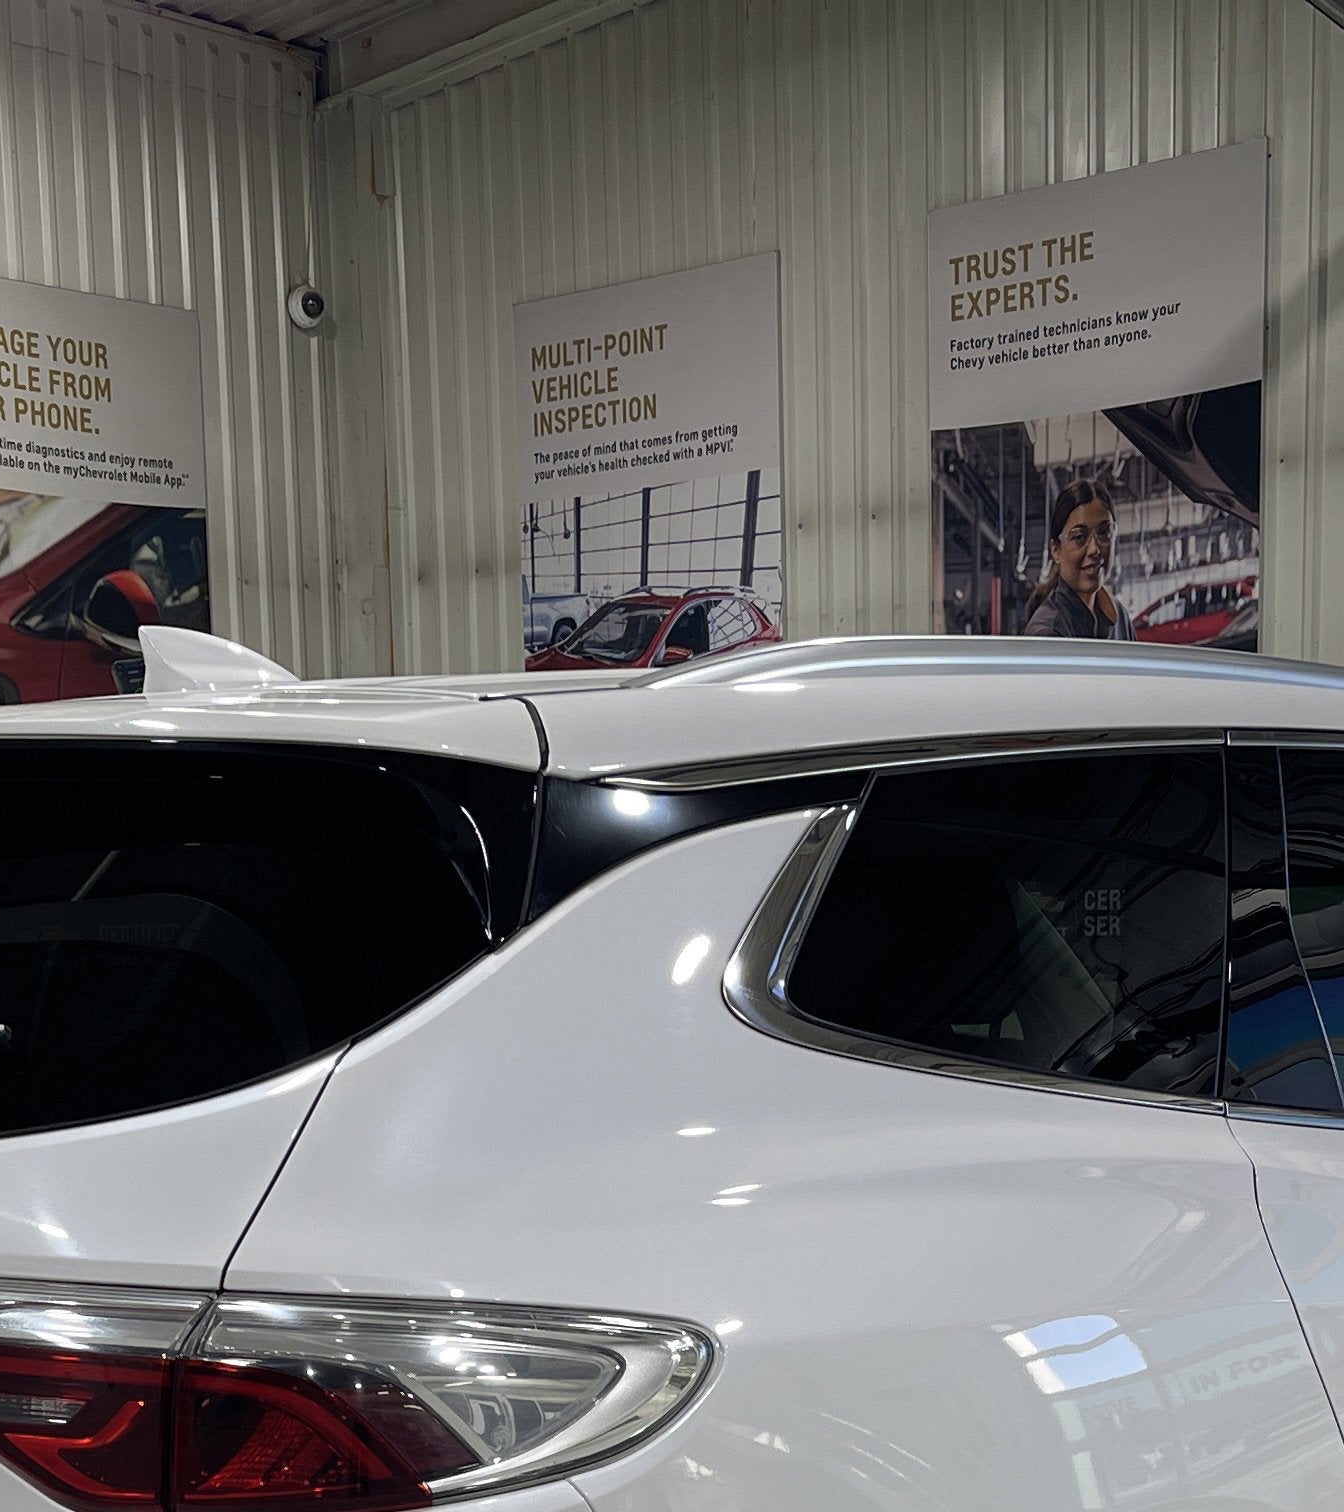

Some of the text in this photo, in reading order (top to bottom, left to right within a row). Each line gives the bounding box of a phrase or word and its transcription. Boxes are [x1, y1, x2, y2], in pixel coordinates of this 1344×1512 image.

[949, 230, 1095, 286] TRUST THE
[950, 274, 1078, 322] EXPERTS.
[949, 302, 1181, 353] Factory trained technicians know your
[47, 335, 108, 369] YOUR
[531, 324, 668, 372] MULTI-POINT
[950, 328, 1152, 371] Chevy vehicle better than anyone.
[49, 369, 112, 403] FROM
[531, 366, 619, 404] VEHICLE
[14, 397, 100, 435] PHONE.
[533, 393, 657, 438] INSPECTION
[25, 441, 85, 460] diagnostics
[88, 450, 106, 463] and
[109, 452, 135, 468] enjoy
[138, 457, 173, 469] remote
[534, 423, 738, 465] The peace of mind that comes from getting
[27, 461, 40, 471] on
[43, 460, 60, 474] the
[63, 465, 128, 482] myChevrolet
[130, 470, 161, 485] Mobile
[534, 468, 555, 484] your
[556, 461, 597, 478] vehicle's
[598, 456, 628, 472] health
[630, 450, 670, 468] checked
[673, 445, 694, 461] with
[696, 447, 703, 457] a
